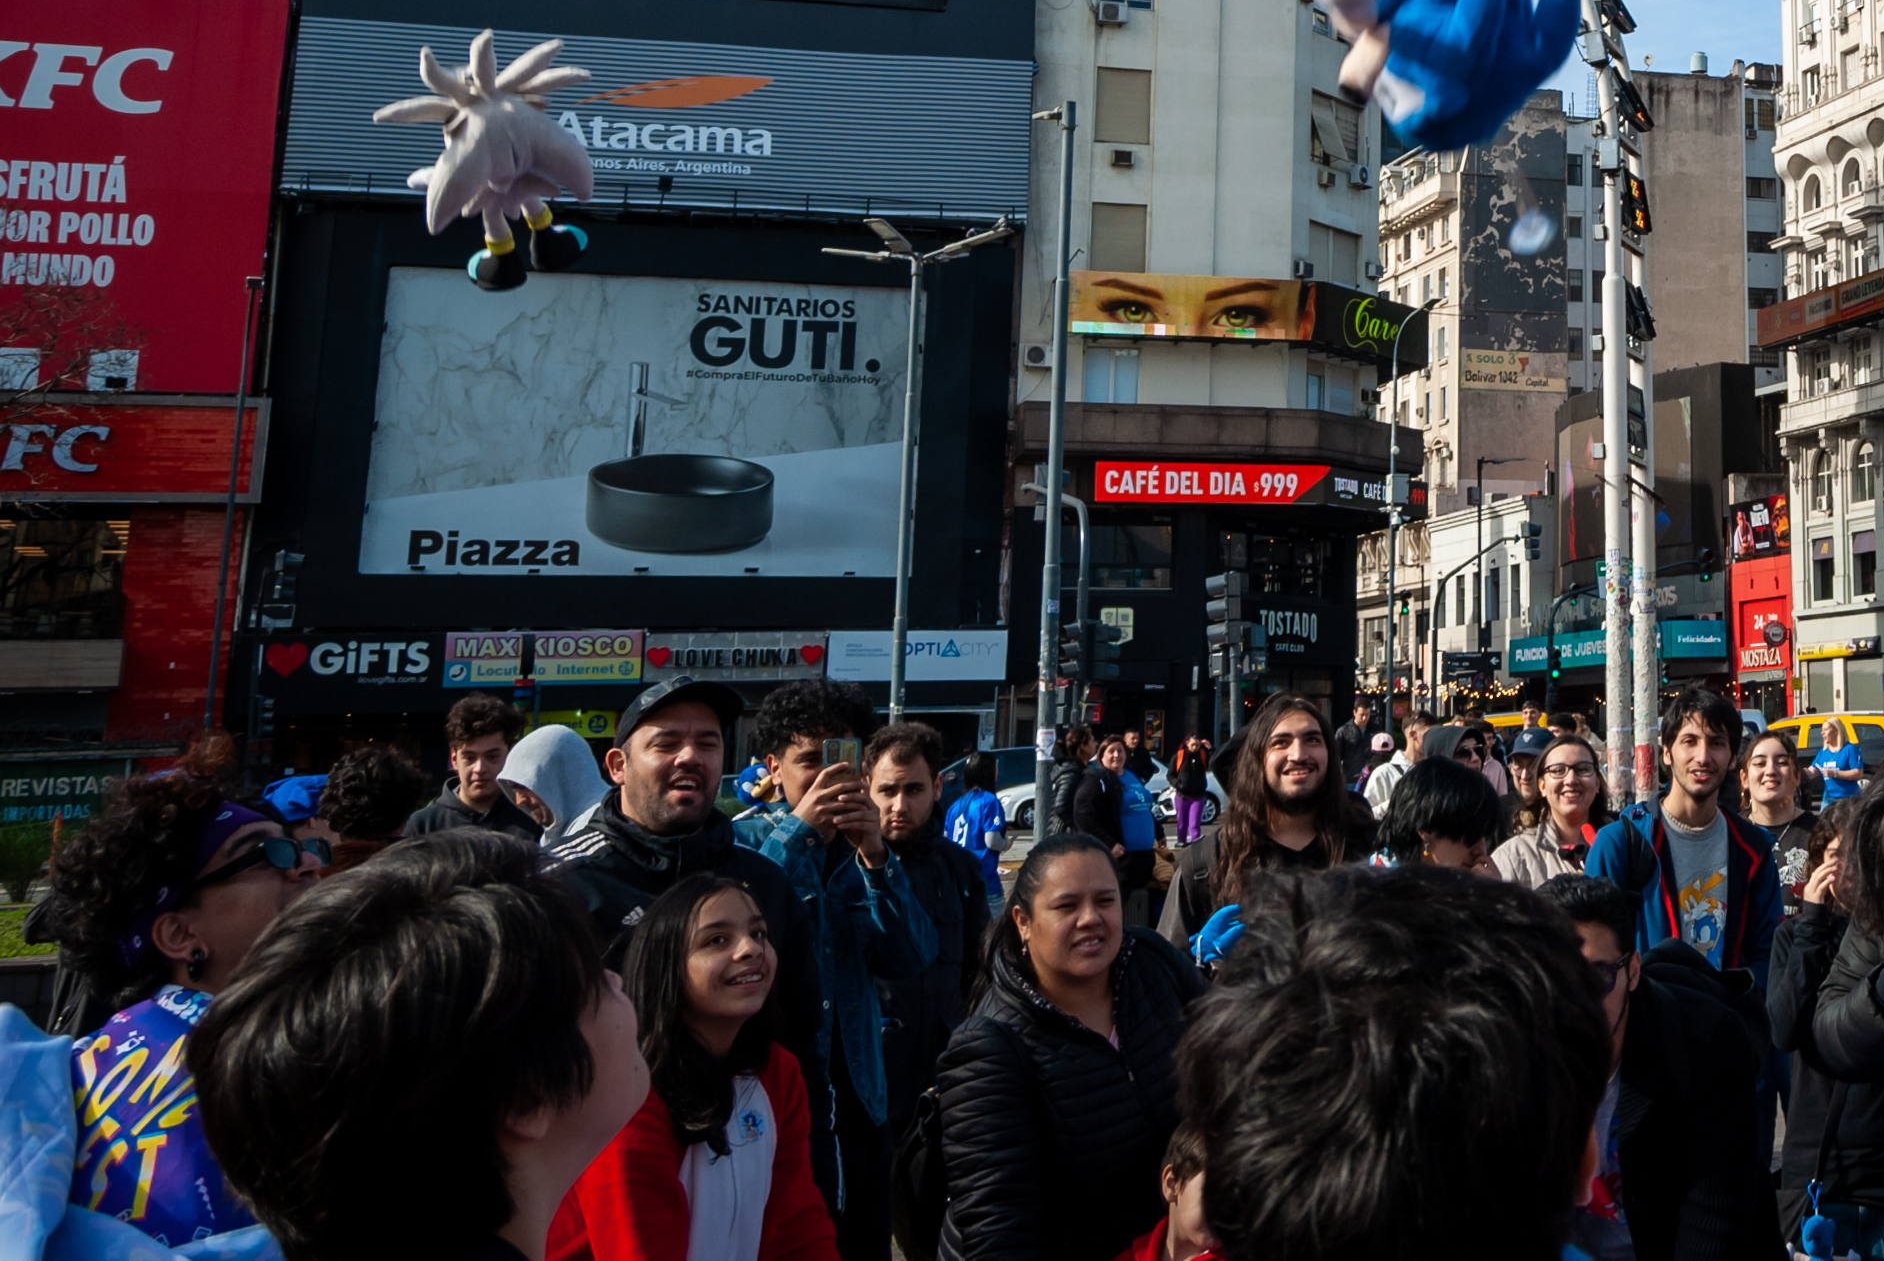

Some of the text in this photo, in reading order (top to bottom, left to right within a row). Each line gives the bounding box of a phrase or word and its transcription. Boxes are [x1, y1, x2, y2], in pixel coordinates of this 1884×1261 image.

[557, 111, 772, 155] Atacama
[626, 158, 670, 173] Aires,
[675, 159, 752, 176] Argentina
[57, 211, 156, 246] POLLO
[2, 252, 116, 287] MUNDO
[696, 293, 856, 319] SANITARIOS
[690, 315, 881, 374] GUTI.
[1476, 354, 1505, 365] SOLO
[1498, 370, 1519, 384] 1042
[1104, 465, 1299, 498] CAFÉ DEL DIA $999
[1334, 477, 1359, 495] TOSTADO
[1363, 480, 1382, 500] CAFÉ
[407, 529, 580, 568] Piazza
[1260, 609, 1318, 643] TOSTADO
[535, 635, 634, 657] KIOSCO
[1677, 634, 1722, 644] Felicidades
[309, 640, 431, 676] GiFTS
[674, 647, 797, 668] LOVE CHUKA
[1561, 644, 1572, 658] DE
[1740, 647, 1783, 668] MOSTAZA
[556, 662, 615, 677] Internet
[1, 775, 112, 797] REVISTAS
[3, 803, 91, 821] IMPORTADAS
